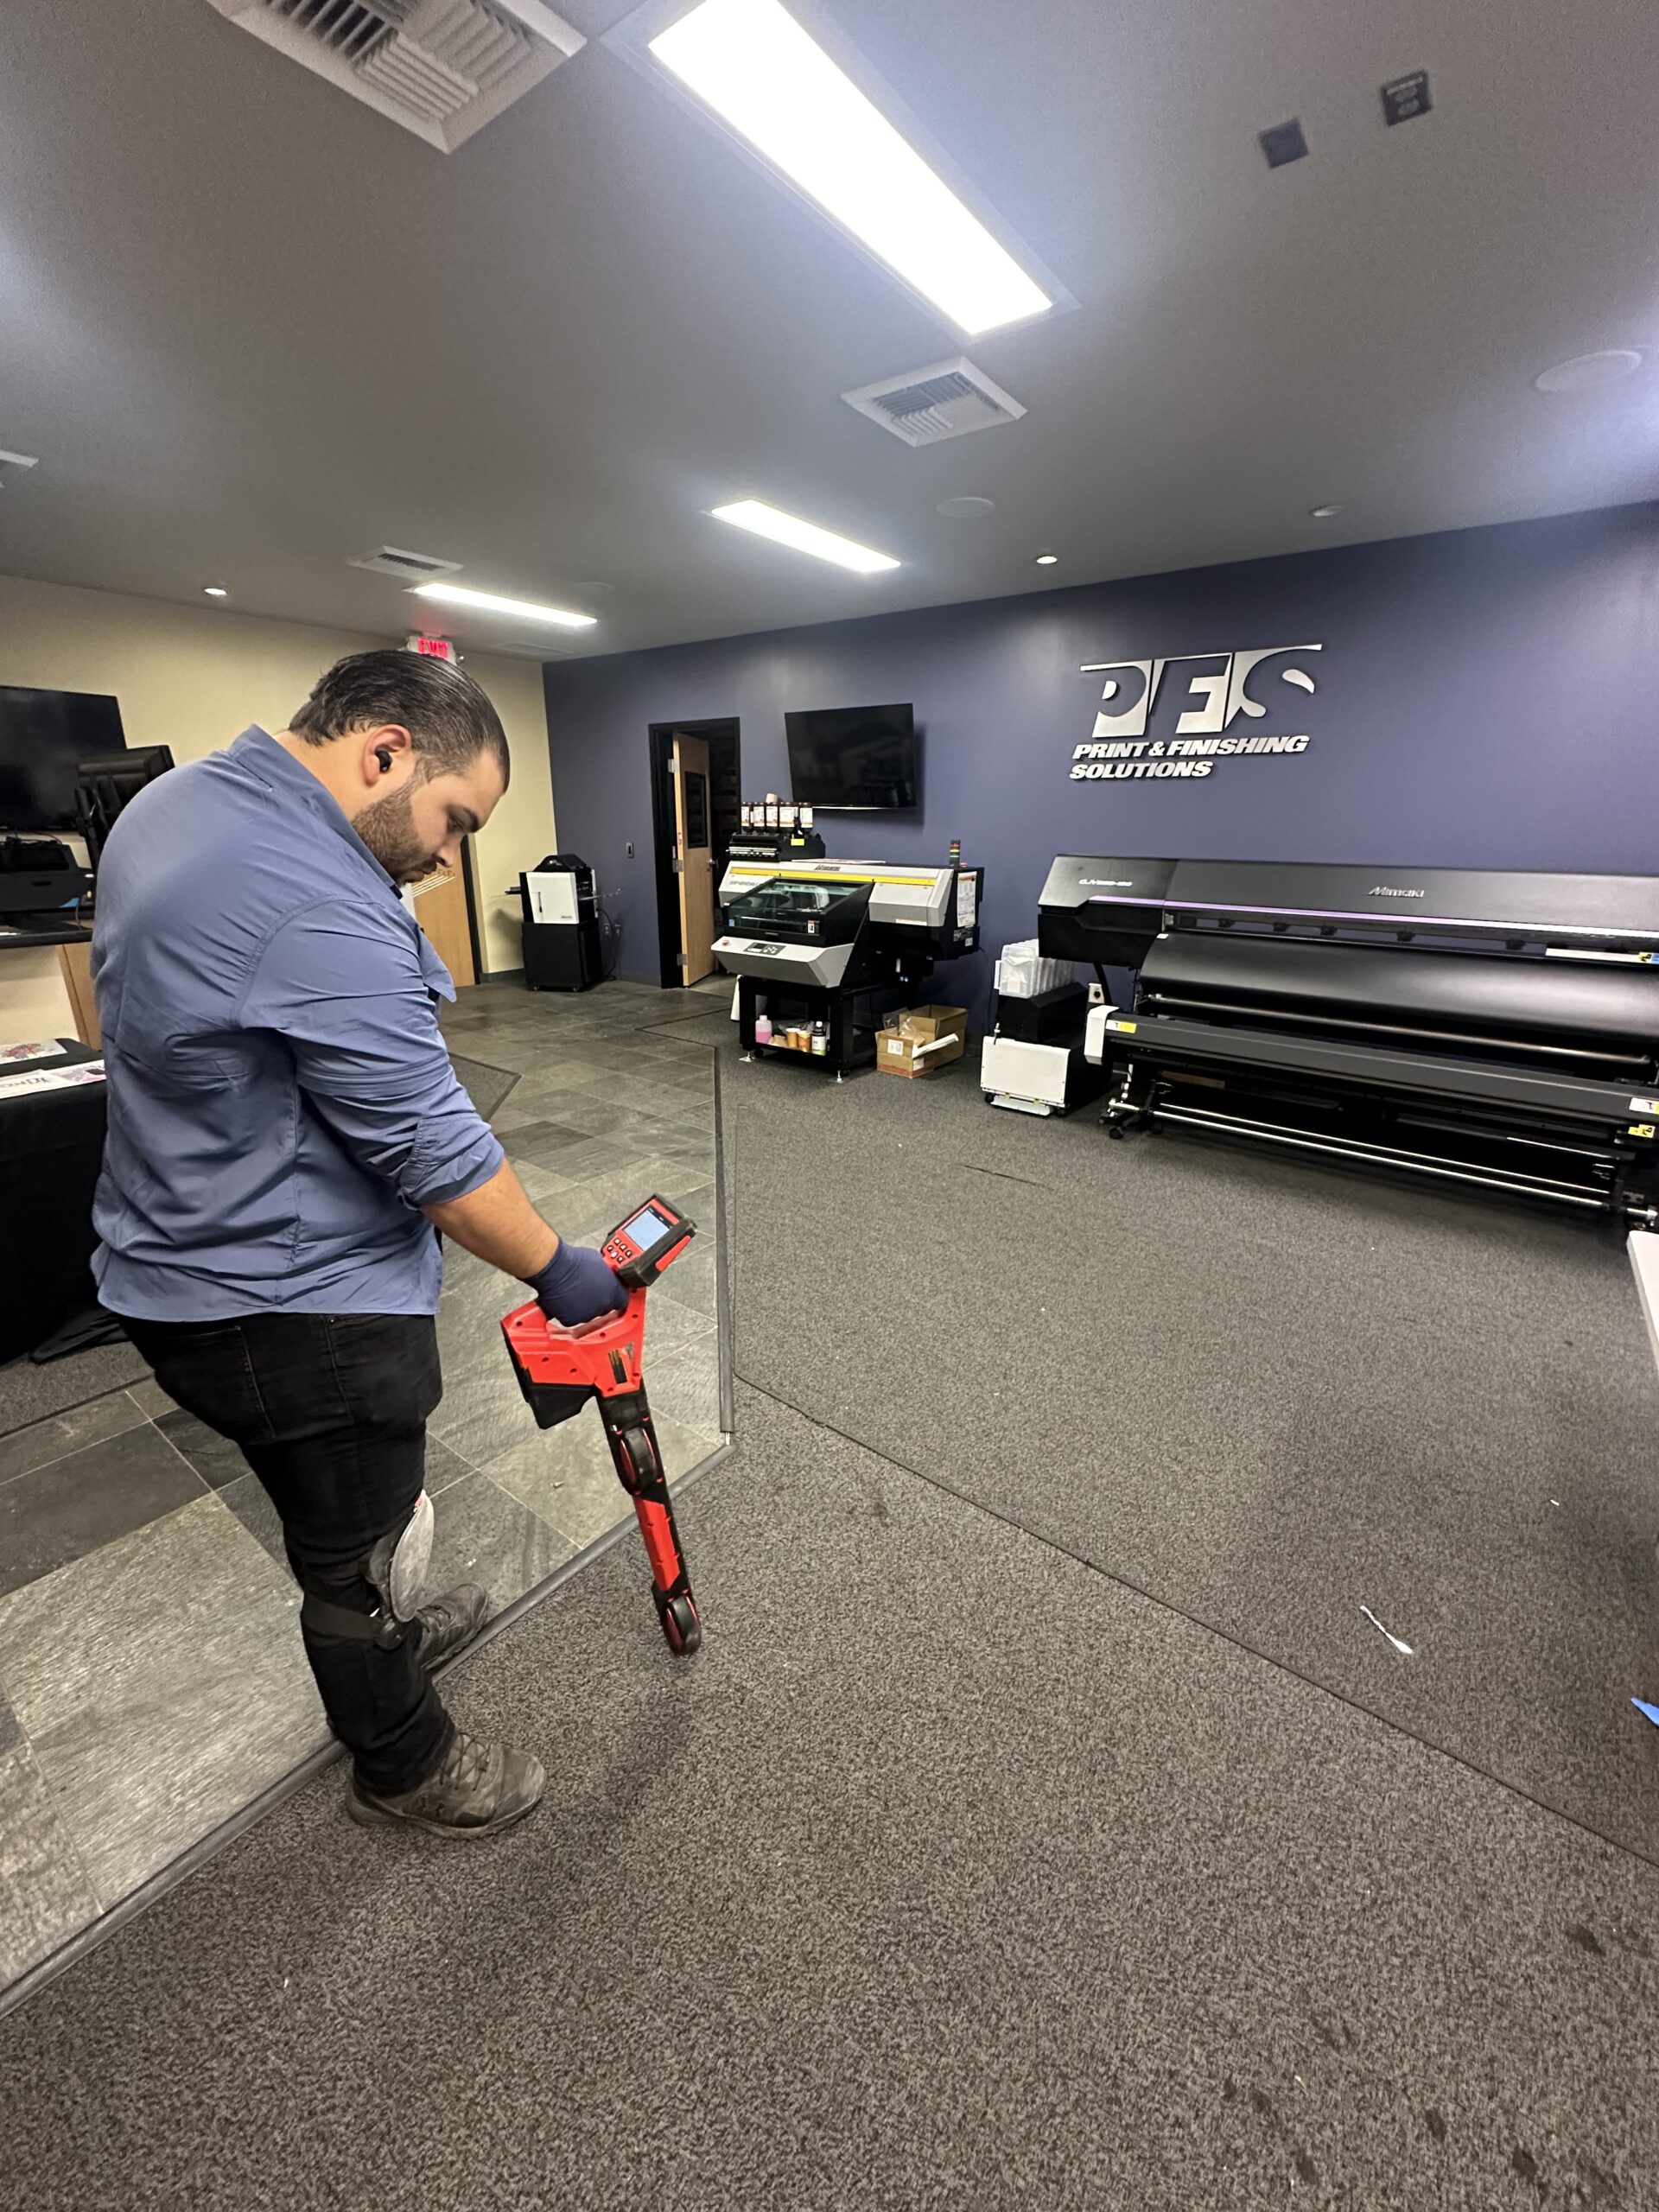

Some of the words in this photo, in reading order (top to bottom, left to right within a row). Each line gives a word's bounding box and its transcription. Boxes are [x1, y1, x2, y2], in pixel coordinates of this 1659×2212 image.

[1072, 741, 1149, 760] PRINT
[1148, 741, 1166, 757] &
[1166, 735, 1309, 757] FINISHING
[1069, 761, 1213, 779] SOLUTIONS
[1368, 887, 1425, 898] Mimaki
